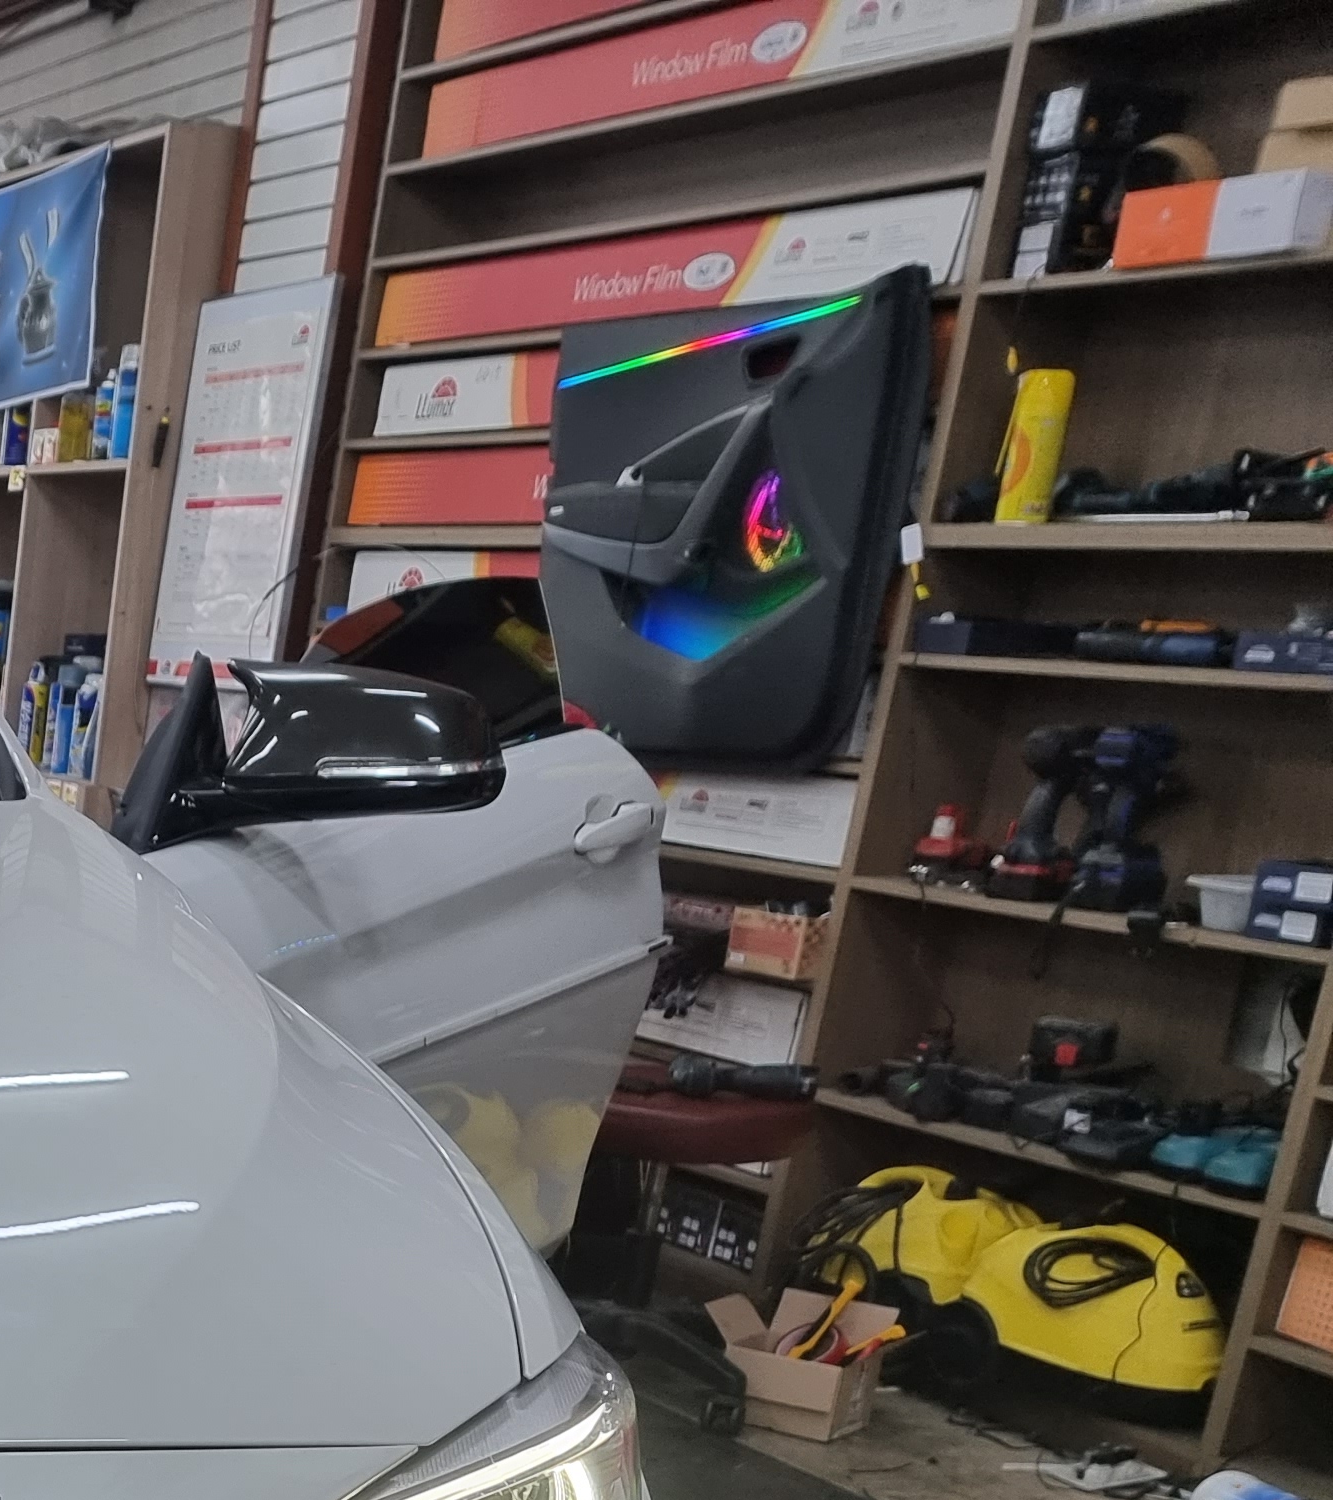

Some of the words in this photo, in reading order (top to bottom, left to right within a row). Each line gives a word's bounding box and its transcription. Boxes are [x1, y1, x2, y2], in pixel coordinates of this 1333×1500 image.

[632, 50, 706, 86] Window
[706, 38, 748, 70] Film
[574, 269, 645, 301] Window
[643, 264, 683, 294] Film
